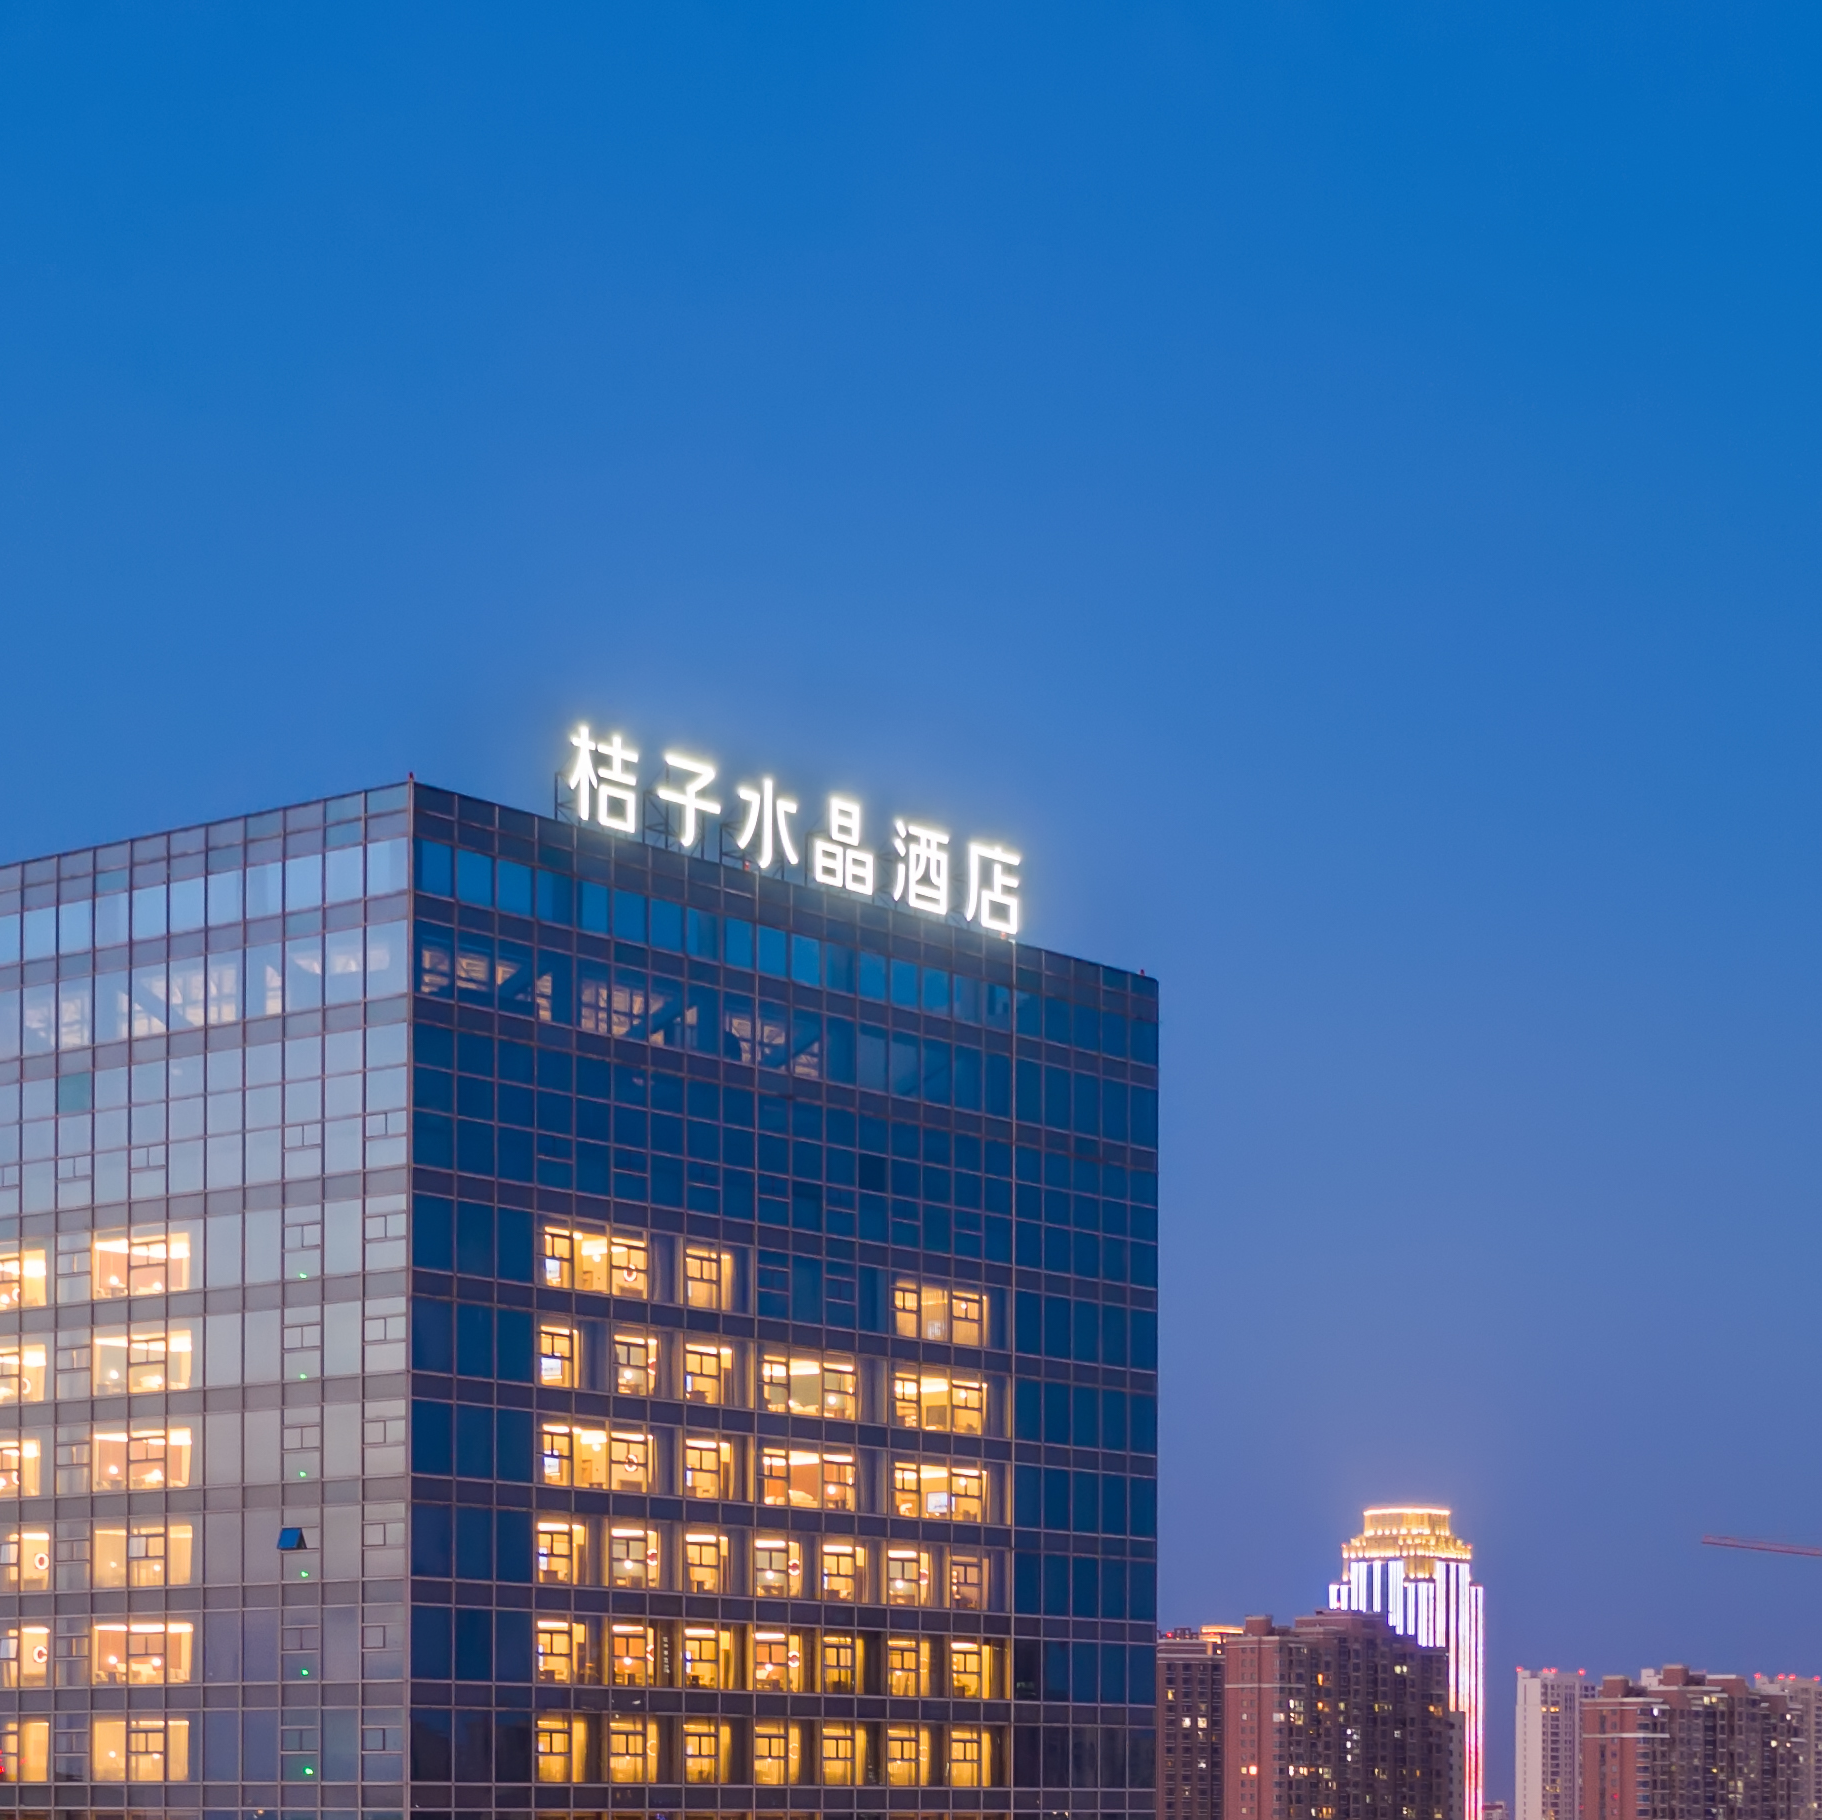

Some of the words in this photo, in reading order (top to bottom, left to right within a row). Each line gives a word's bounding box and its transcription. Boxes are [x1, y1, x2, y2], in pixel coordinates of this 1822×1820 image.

[568, 723, 1022, 935] 桔子水晶酒店
